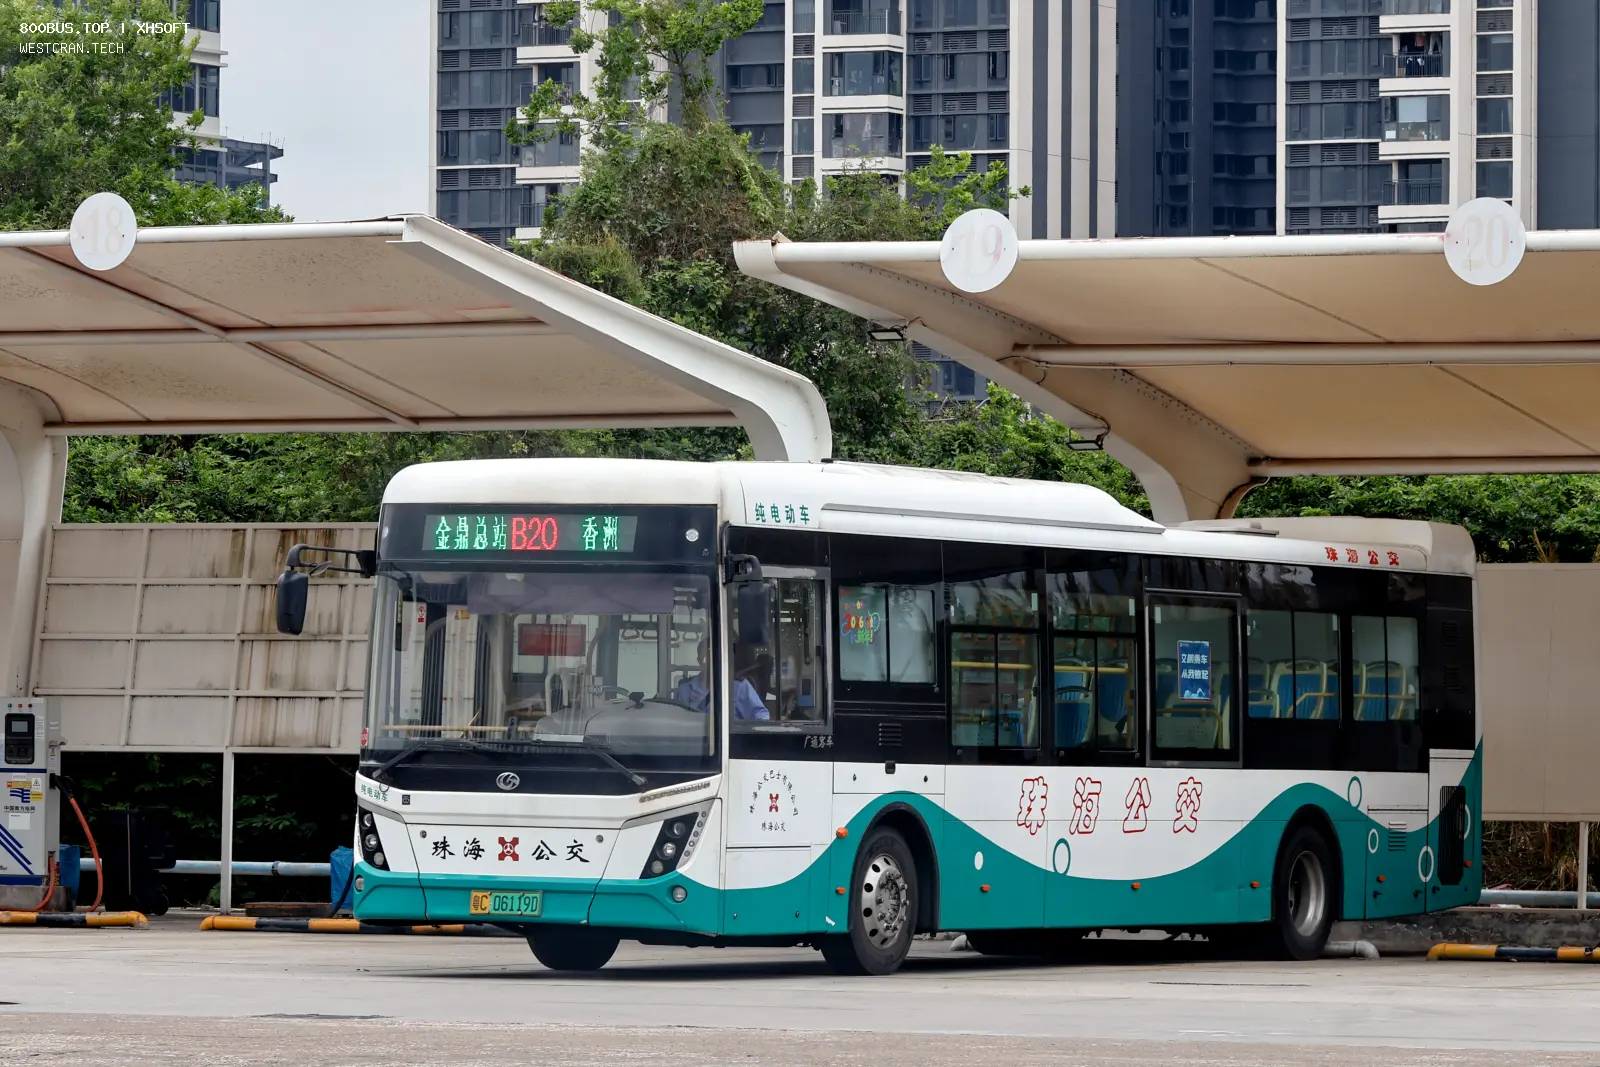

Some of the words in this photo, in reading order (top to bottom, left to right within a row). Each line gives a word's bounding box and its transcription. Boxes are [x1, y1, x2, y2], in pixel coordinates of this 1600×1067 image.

[86, 206, 124, 255] 18
[958, 222, 1003, 276] 19
[1461, 213, 1510, 270] 20
[511, 517, 557, 550] B20
[582, 516, 618, 550] 香洲
[755, 502, 810, 525] 纯电动车
[1324, 546, 1399, 566] 珠海公交
[803, 735, 834, 748] 广通客车
[1016, 776, 1203, 835] 珠海公交
